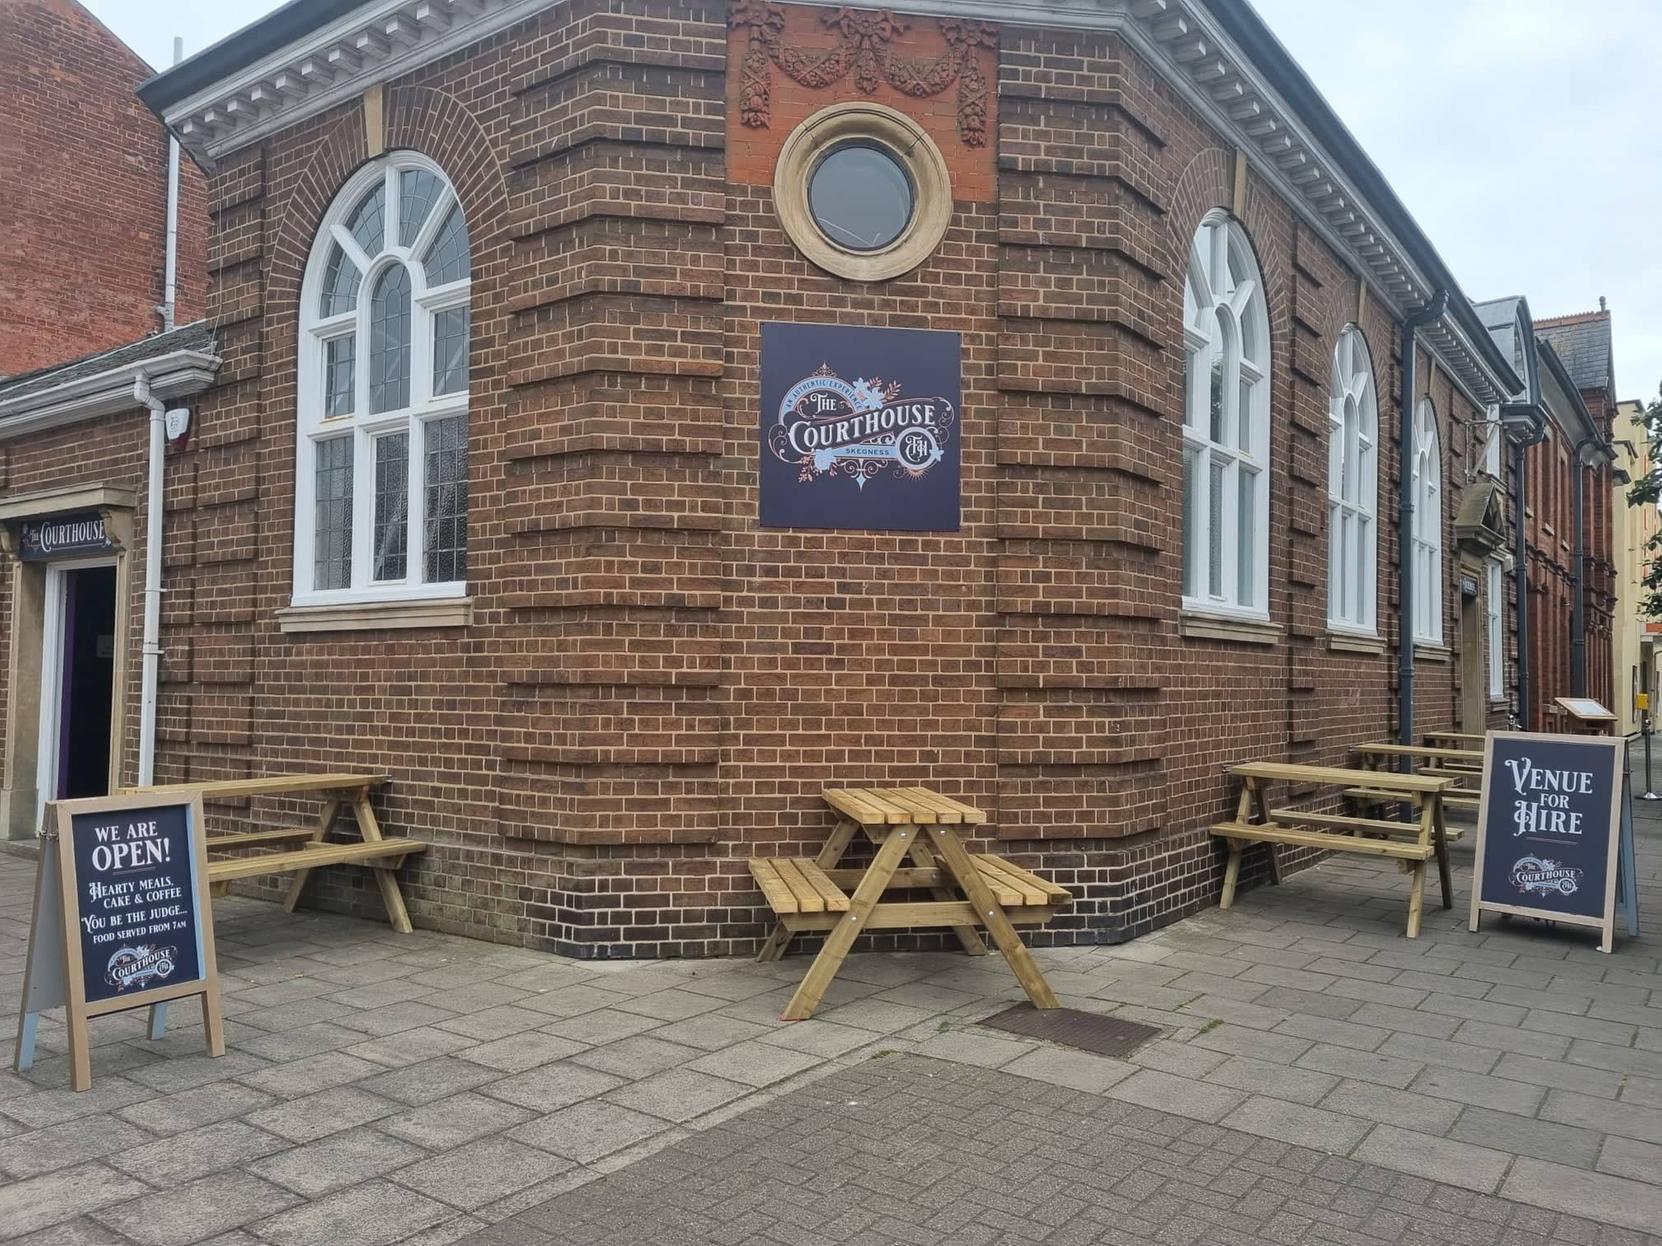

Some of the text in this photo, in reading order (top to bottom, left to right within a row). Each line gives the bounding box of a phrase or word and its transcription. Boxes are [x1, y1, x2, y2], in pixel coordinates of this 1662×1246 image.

[793, 380, 826, 398] AUTHENTIC
[810, 393, 837, 414] THE
[788, 404, 936, 455] COURTHOUSE
[846, 448, 890, 456] SKEGNESS
[40, 520, 105, 552] COURTHOUSE
[1504, 757, 1593, 796] VENUE
[1540, 793, 1570, 809] FOR
[1513, 800, 1584, 837] HIRE
[94, 821, 158, 842] WE ARE
[91, 837, 171, 871] OPEN!
[1516, 869, 1576, 884] COURTHOUSE
[88, 881, 135, 903] HEARTY
[103, 887, 182, 909] CAKE & COFFEE
[81, 914, 106, 934] YOU
[110, 914, 123, 926] BE
[126, 910, 147, 924] THE
[93, 920, 187, 944] FOOD SERVED FROM 7AM
[112, 949, 170, 981] COURTHOUSE
